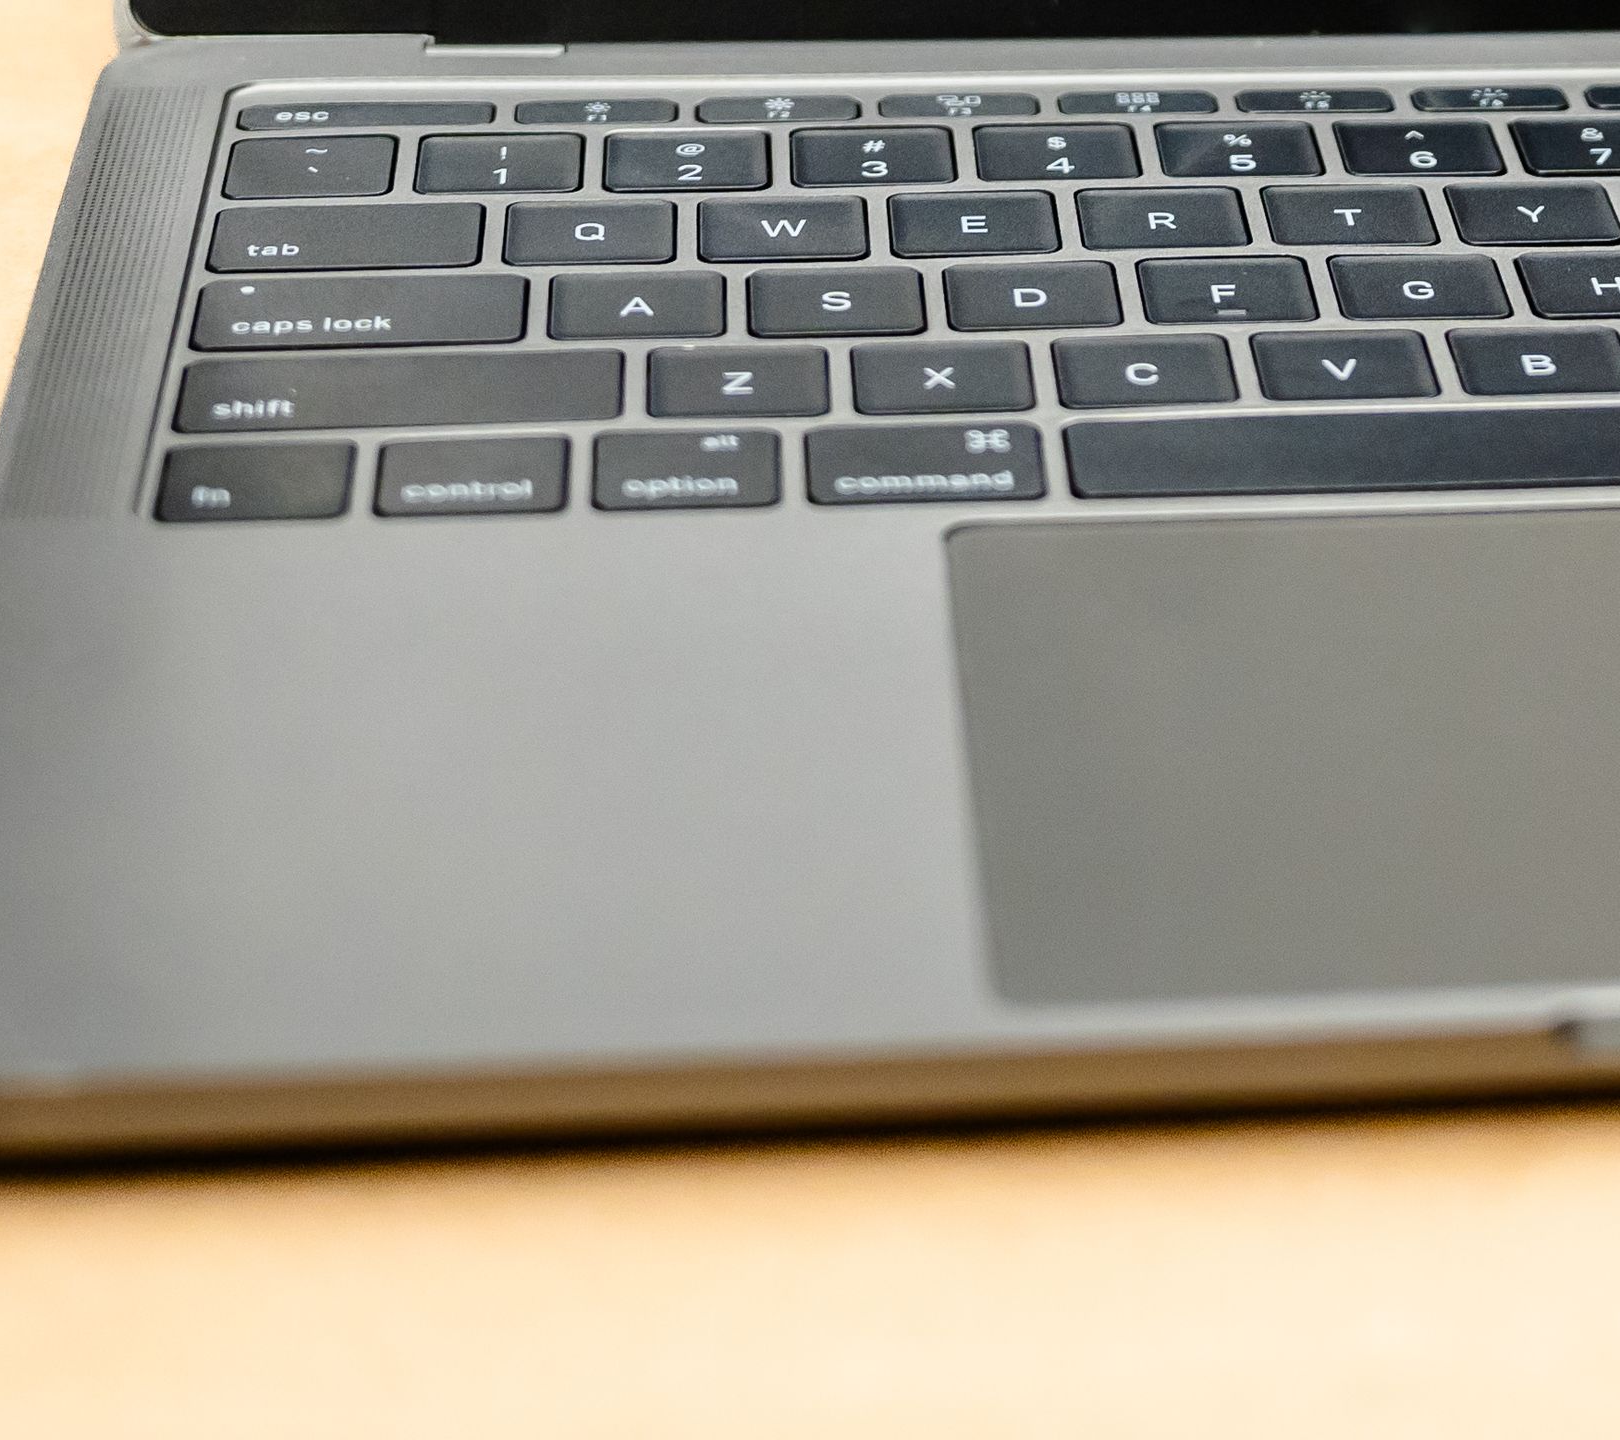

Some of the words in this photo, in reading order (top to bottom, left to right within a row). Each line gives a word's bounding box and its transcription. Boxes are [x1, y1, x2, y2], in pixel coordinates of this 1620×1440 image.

[276, 112, 329, 122] esc
[1230, 155, 1256, 171] 5
[1410, 151, 1437, 168] 6
[1590, 148, 1612, 165] 7
[678, 165, 702, 180] 2
[862, 161, 888, 177] 3
[1046, 158, 1074, 173] 4
[493, 168, 507, 184] 1
[1148, 213, 1176, 229] R
[1334, 209, 1361, 225] T
[1517, 206, 1544, 222] Y
[575, 223, 604, 240] Q
[761, 220, 806, 237] W
[961, 216, 988, 233] E
[247, 244, 299, 256] tab
[1013, 288, 1047, 307] D
[1211, 285, 1235, 303] F
[1403, 281, 1434, 299] G
[620, 297, 653, 316] A
[822, 292, 851, 311] S
[232, 320, 312, 335] caps
[323, 316, 391, 331] lock
[1126, 363, 1158, 385] C
[1322, 359, 1356, 380] V
[1521, 355, 1556, 376] B
[723, 372, 753, 395] Z
[924, 367, 955, 389] X
[210, 399, 296, 418] shift
[835, 470, 1014, 494] command
